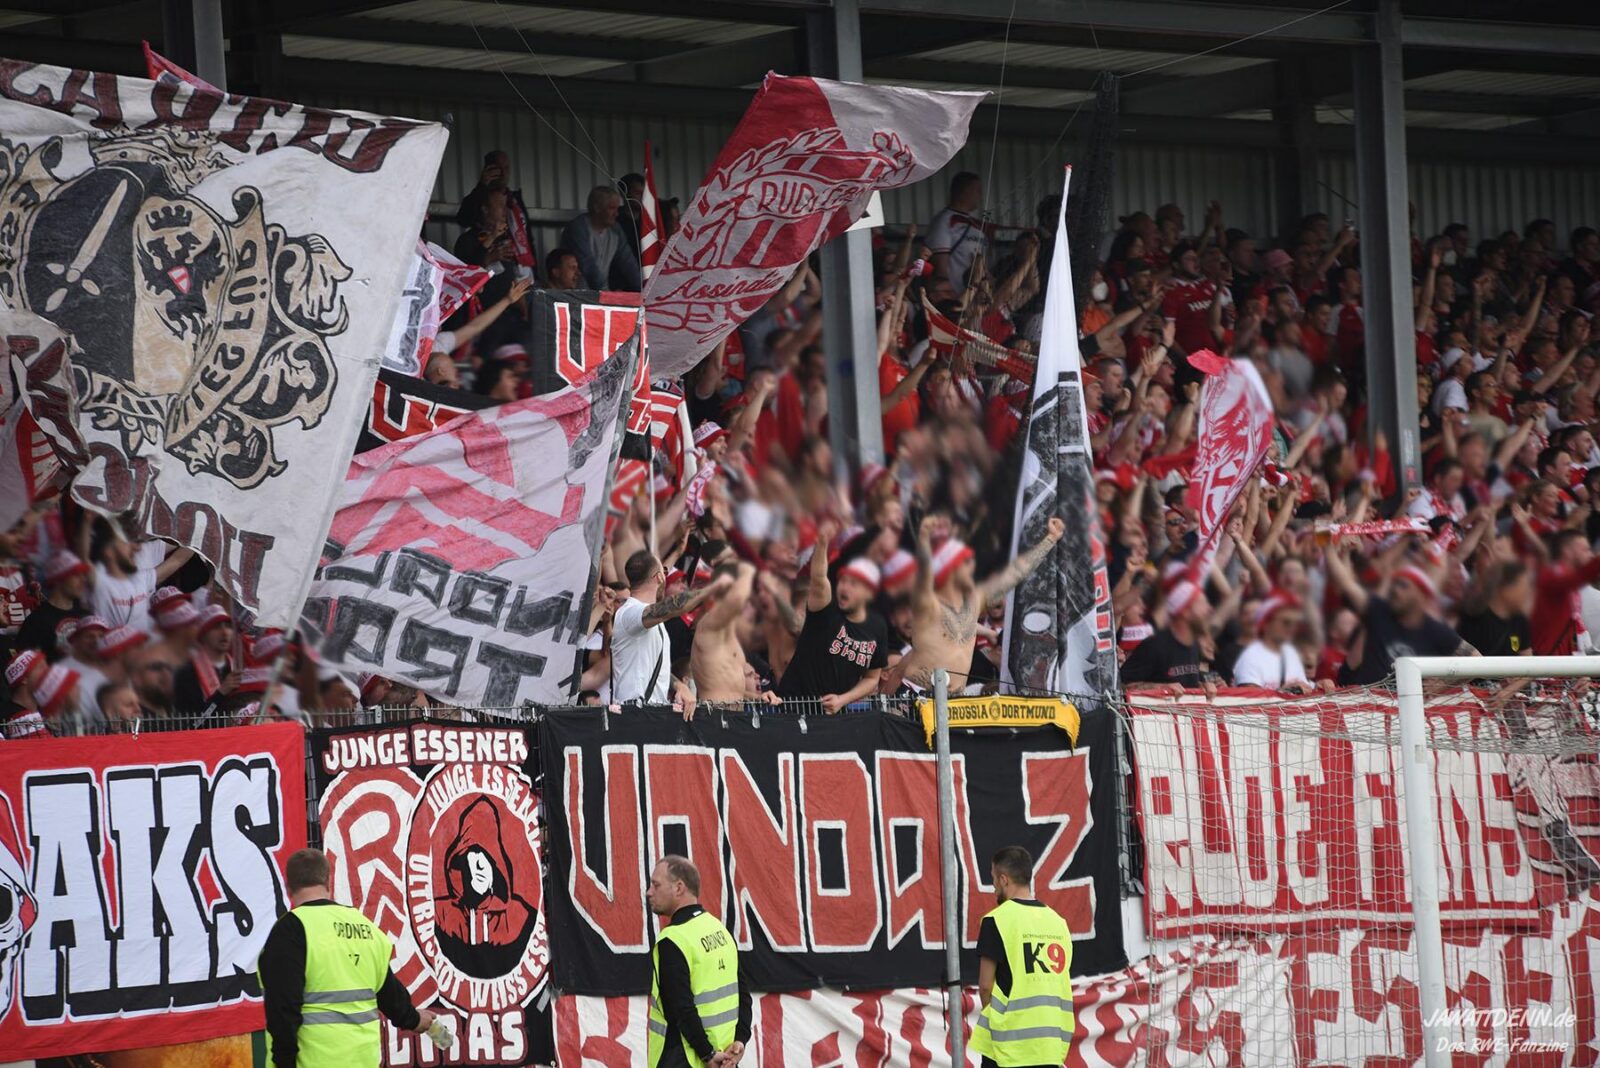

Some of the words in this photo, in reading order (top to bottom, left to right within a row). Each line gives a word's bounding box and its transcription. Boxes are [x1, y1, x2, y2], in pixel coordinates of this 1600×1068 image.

[829, 639, 873, 669] SPORT
[947, 703, 989, 721] ORUSSIA
[1001, 703, 1056, 720] DORTMUND
[324, 732, 409, 771] JUNGE
[413, 729, 529, 763] ESSENER
[427, 763, 477, 815] JUNGE
[1022, 941, 1066, 975] K9
